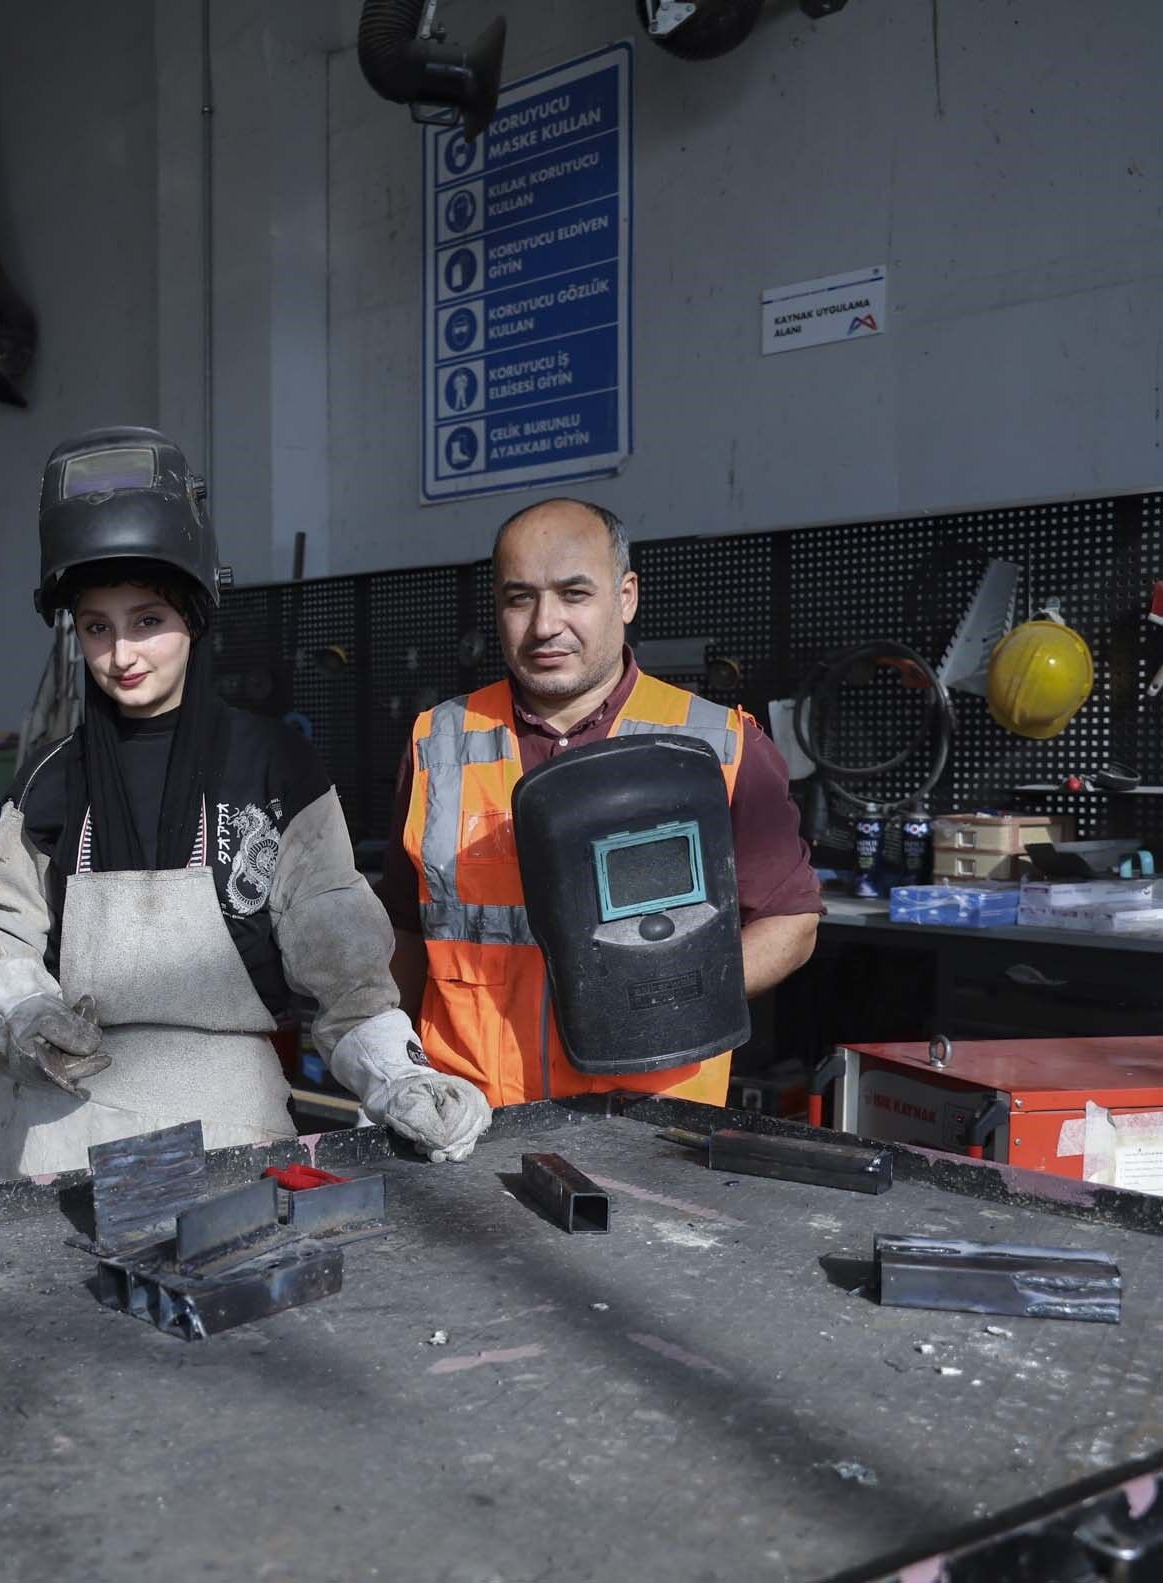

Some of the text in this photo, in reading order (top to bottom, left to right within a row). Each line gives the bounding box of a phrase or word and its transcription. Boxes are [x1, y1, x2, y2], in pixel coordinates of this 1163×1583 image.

[489, 96, 570, 137] KORUYUCU
[488, 108, 602, 160] MASKE KULLAN
[488, 152, 600, 199] KULAK KORUYUCU
[488, 193, 534, 217] KULLAN
[489, 215, 609, 260] KORUYUCU ELDİVEN
[488, 258, 523, 279] GİYİN
[489, 277, 610, 320] KORUYUCU GÖZLÜK
[774, 299, 871, 325] KAYNAK UYGULAMA
[488, 318, 534, 340] KULLAN
[773, 325, 803, 337] ALANI
[489, 350, 570, 381] KORUYUCU İŞ
[489, 371, 573, 400] ELBİSESİ GİYİN
[490, 414, 581, 444] ÇELİK BURUNLU
[490, 431, 590, 460] AYAKKABI GİYİN
